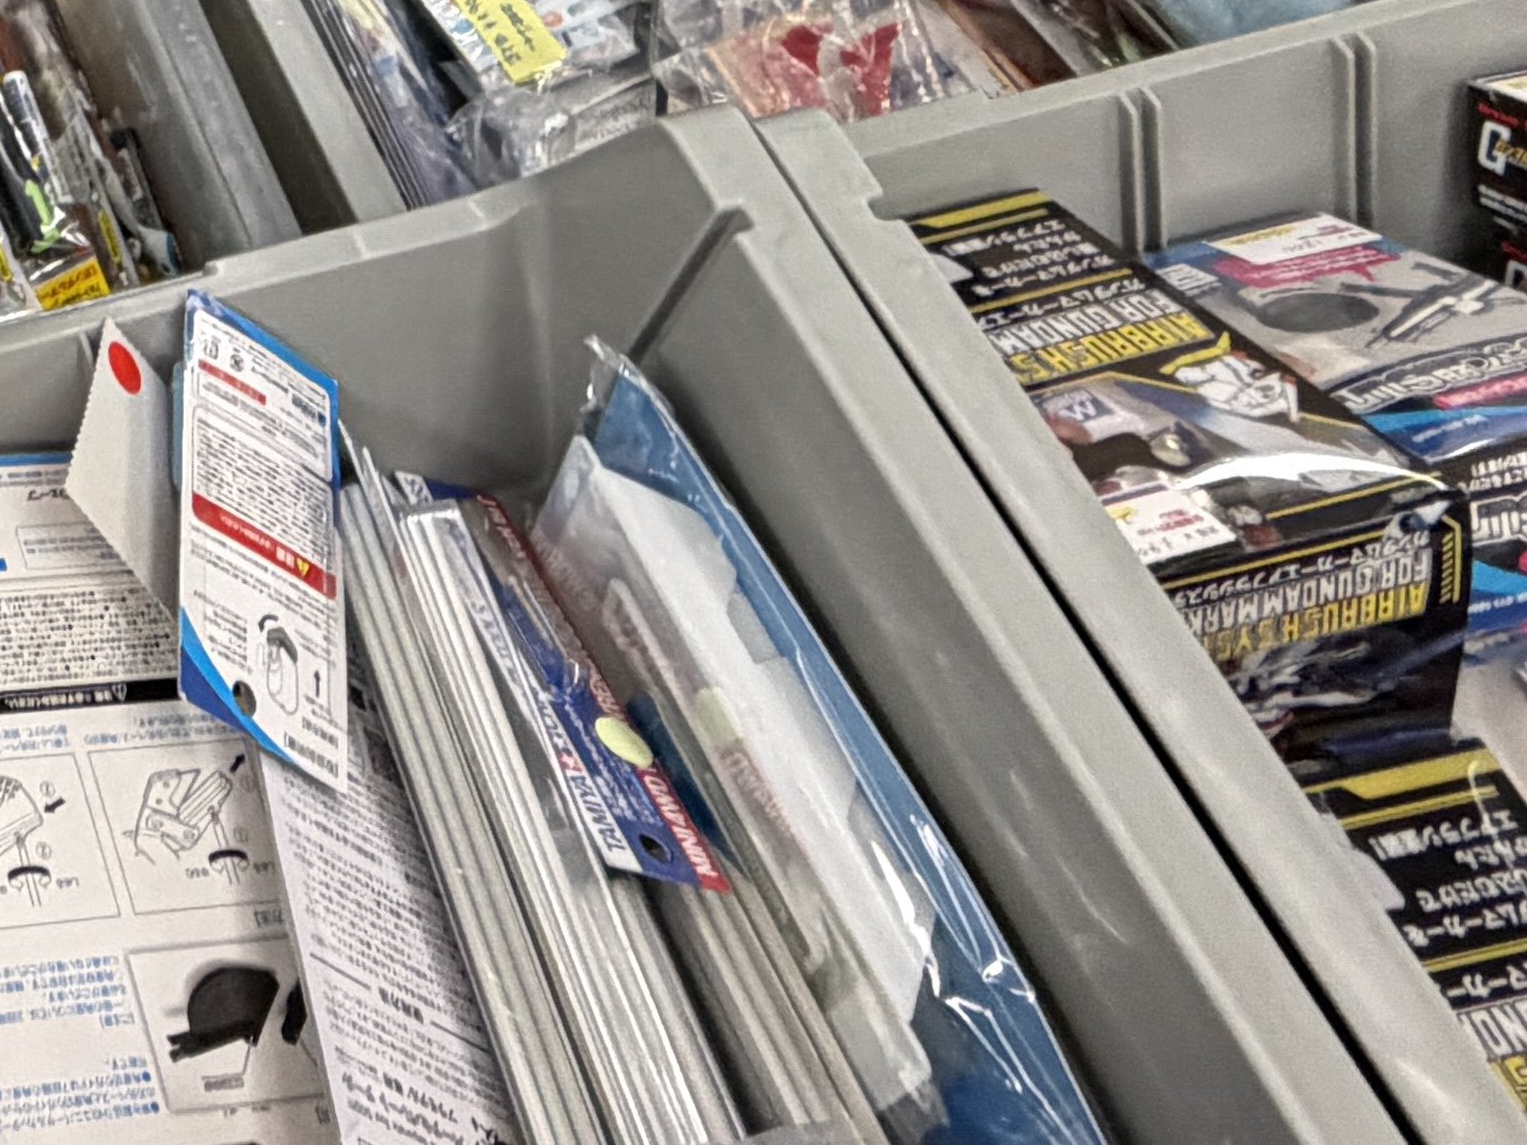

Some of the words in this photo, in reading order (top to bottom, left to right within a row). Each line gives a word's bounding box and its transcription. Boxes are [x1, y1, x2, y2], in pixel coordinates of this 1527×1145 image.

[984, 303, 1119, 356] GUNDAM
[1115, 289, 1176, 324] FOR
[1032, 312, 1211, 379] AIRBRUSH
[1264, 566, 1374, 617] GUNDAM
[1377, 550, 1432, 590] FOR
[1281, 582, 1428, 643] AIRBRUSH
[576, 778, 625, 853] TAMIYA
[683, 828, 715, 876] MINI
